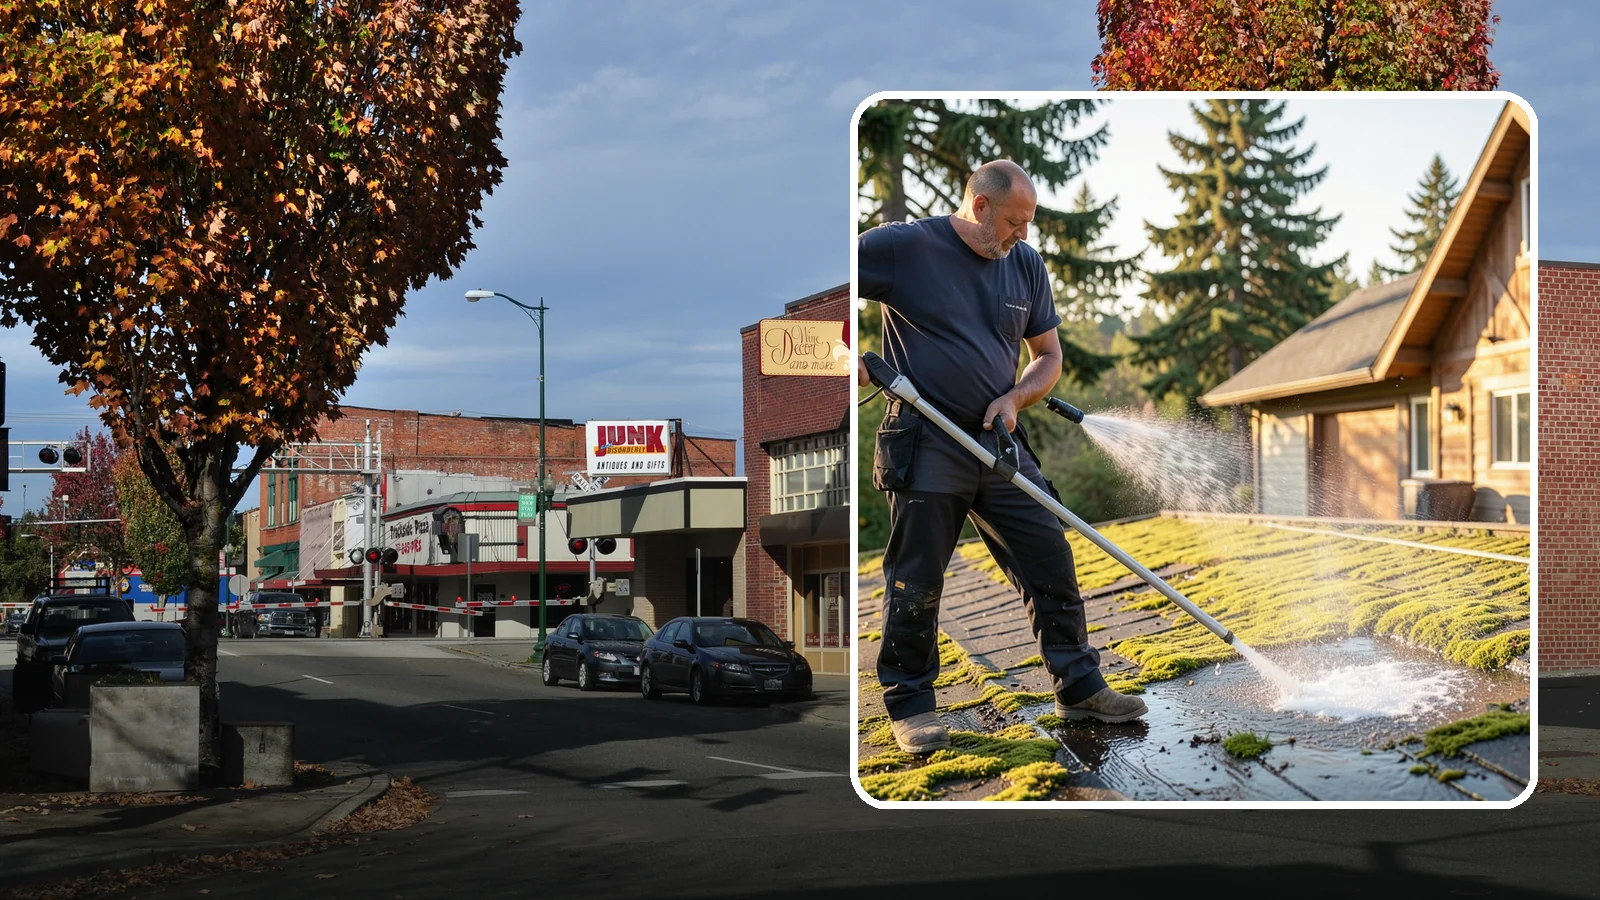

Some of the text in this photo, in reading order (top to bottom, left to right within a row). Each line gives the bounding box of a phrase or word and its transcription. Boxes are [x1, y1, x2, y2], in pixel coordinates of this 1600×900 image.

[595, 425, 665, 457] JUNK
[607, 446, 646, 454] DISORDERLY
[597, 460, 665, 470] ANTIQUES AND GIFTS
[414, 519, 429, 535] Pizza
